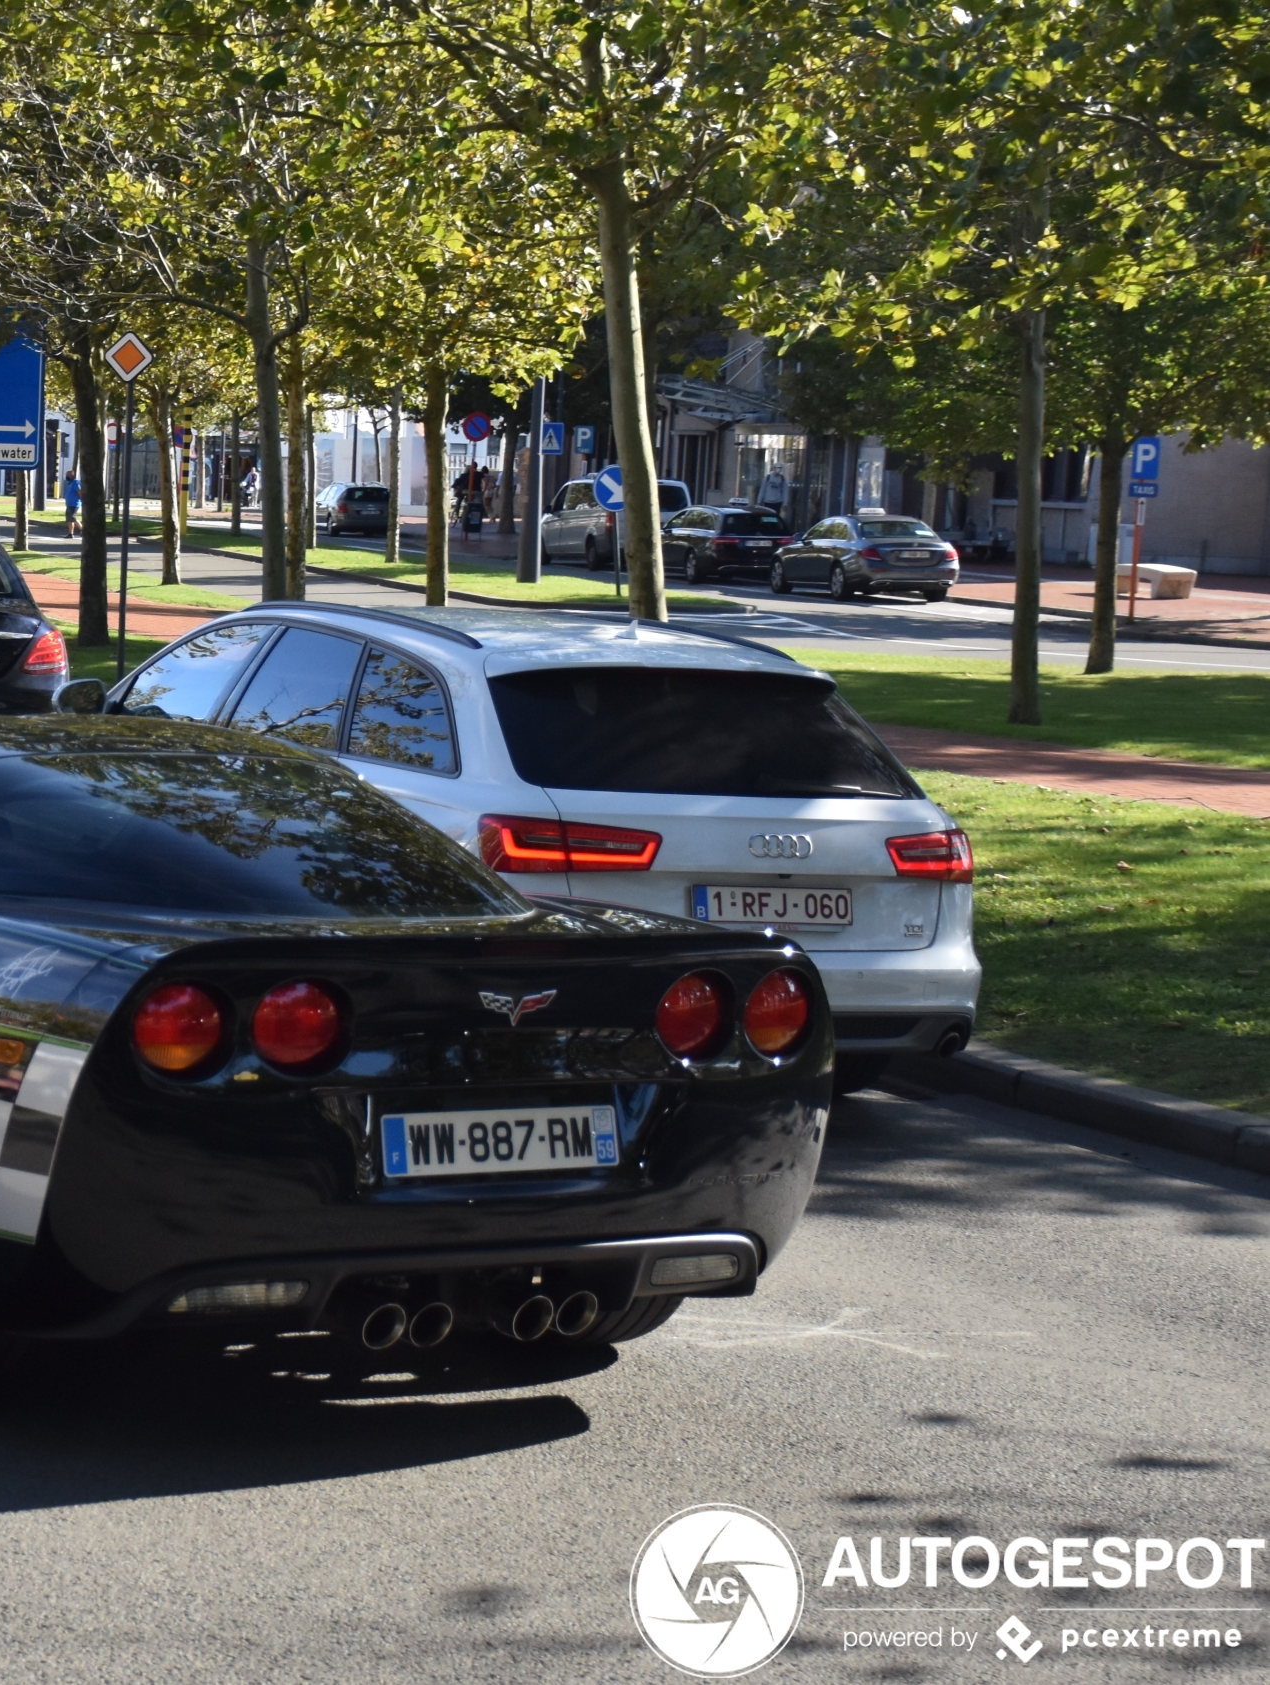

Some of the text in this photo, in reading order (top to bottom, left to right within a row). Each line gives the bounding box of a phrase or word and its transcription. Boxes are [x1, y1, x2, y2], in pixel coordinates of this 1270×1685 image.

[1135, 443, 1156, 473] P
[697, 890, 849, 920] B 1-RFJ-060
[392, 1116, 594, 1166] F WW-887-RM
[597, 1139, 615, 1160] 59
